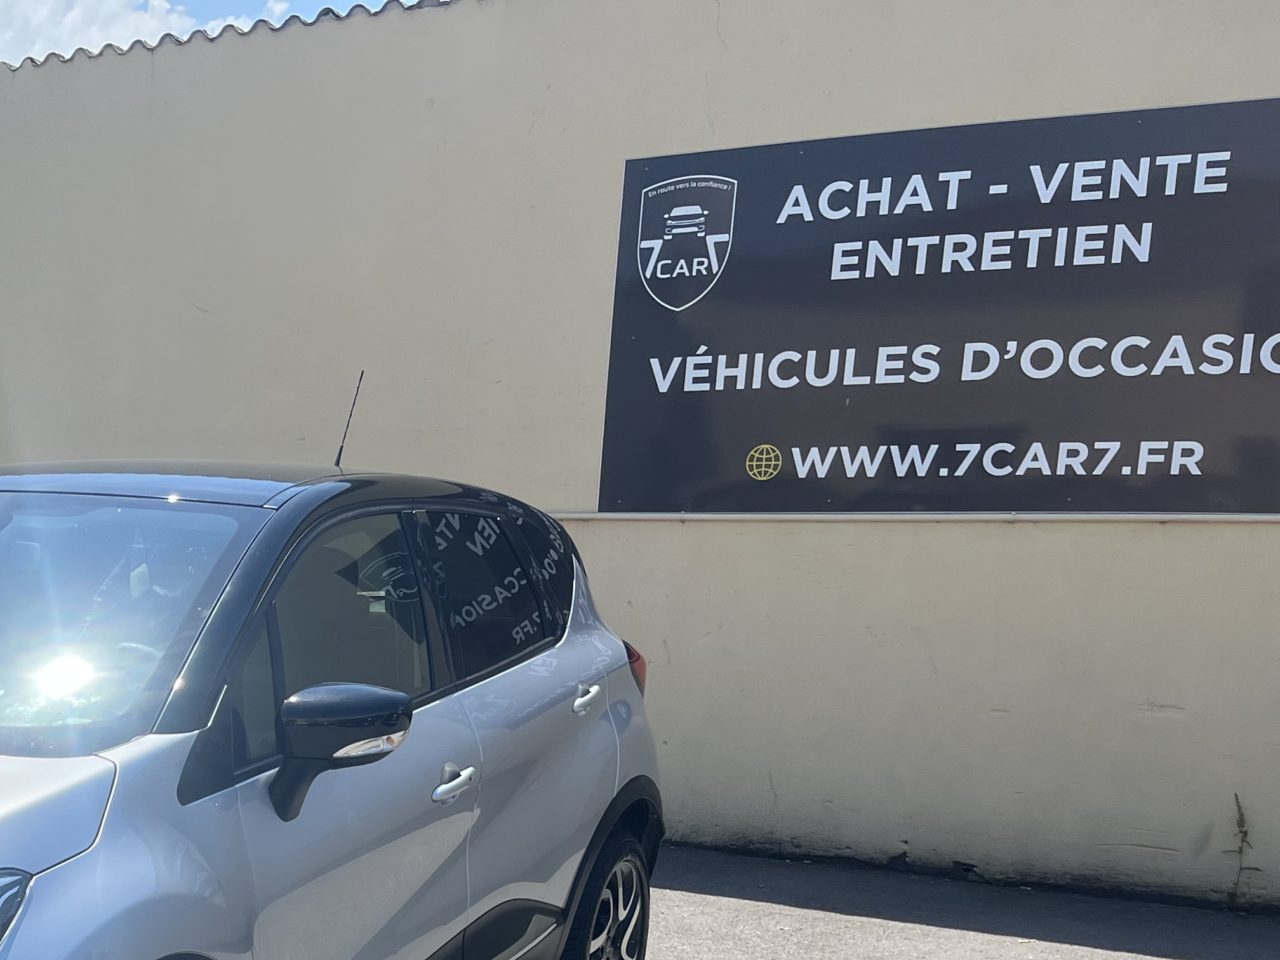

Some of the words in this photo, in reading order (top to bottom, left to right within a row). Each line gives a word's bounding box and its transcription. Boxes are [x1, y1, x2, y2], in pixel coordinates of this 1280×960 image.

[775, 170, 972, 224] ACHAT
[1029, 151, 1232, 204] VENTE
[830, 222, 1153, 280] ENTRETIEN
[649, 344, 941, 393] VÉHICULES
[791, 440, 1204, 479] WWW.7CAR7.FR
